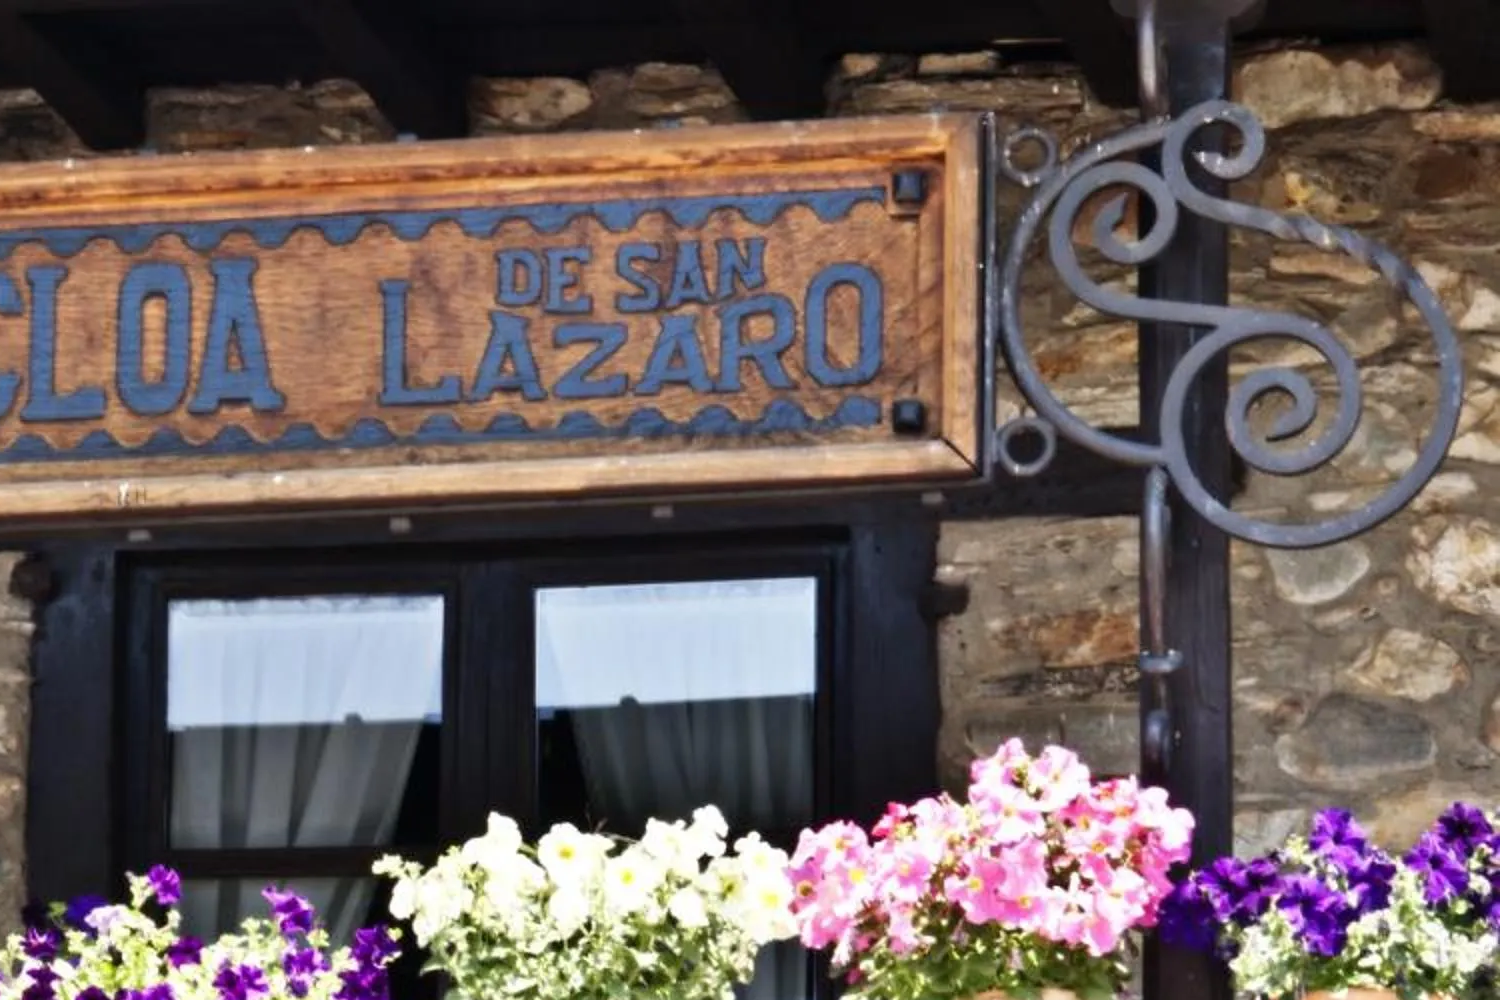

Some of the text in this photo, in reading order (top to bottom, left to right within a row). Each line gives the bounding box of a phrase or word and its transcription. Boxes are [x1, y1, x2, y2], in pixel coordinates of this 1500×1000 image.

[498, 236, 767, 315] DE SAN
[378, 262, 885, 407] LAZARO
